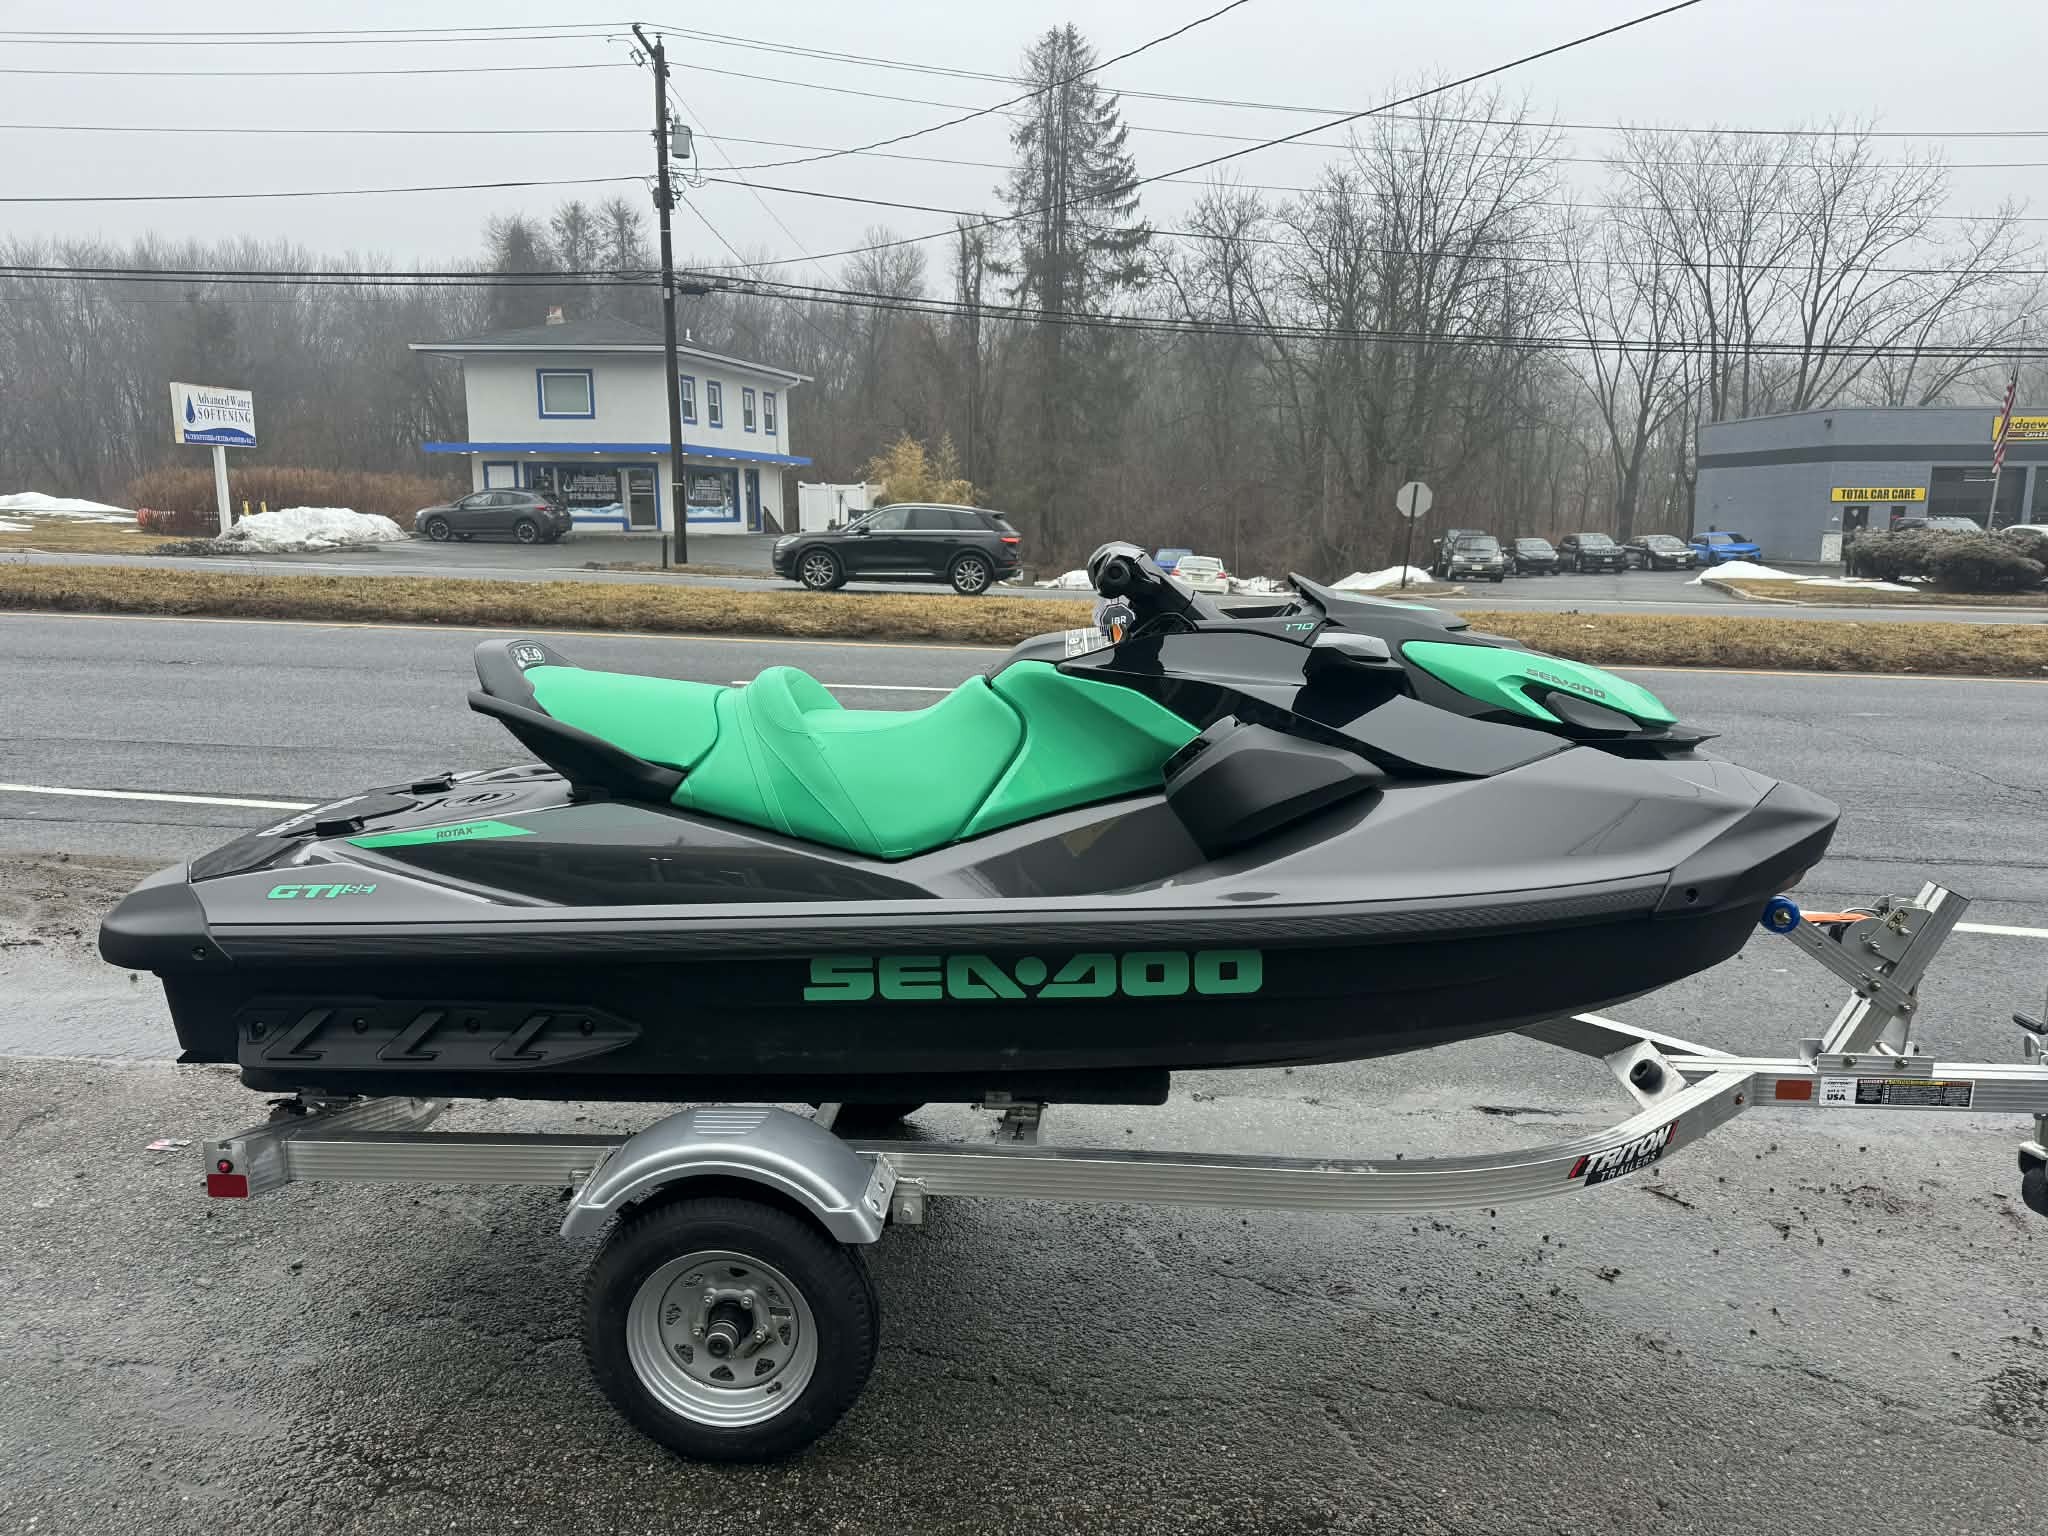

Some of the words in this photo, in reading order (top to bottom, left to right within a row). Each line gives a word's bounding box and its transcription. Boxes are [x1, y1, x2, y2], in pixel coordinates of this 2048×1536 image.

[197, 392, 229, 406] Advanced
[230, 394, 251, 408] Water
[197, 407, 251, 423] SOFTENING
[1841, 489, 1869, 499] TOTAL
[1871, 489, 1890, 499] CAR
[1892, 489, 1916, 499] CARE
[436, 827, 472, 840] ROTAX
[1584, 1123, 1673, 1175] TRITON
[1601, 1152, 1657, 1181] TRAILERS
